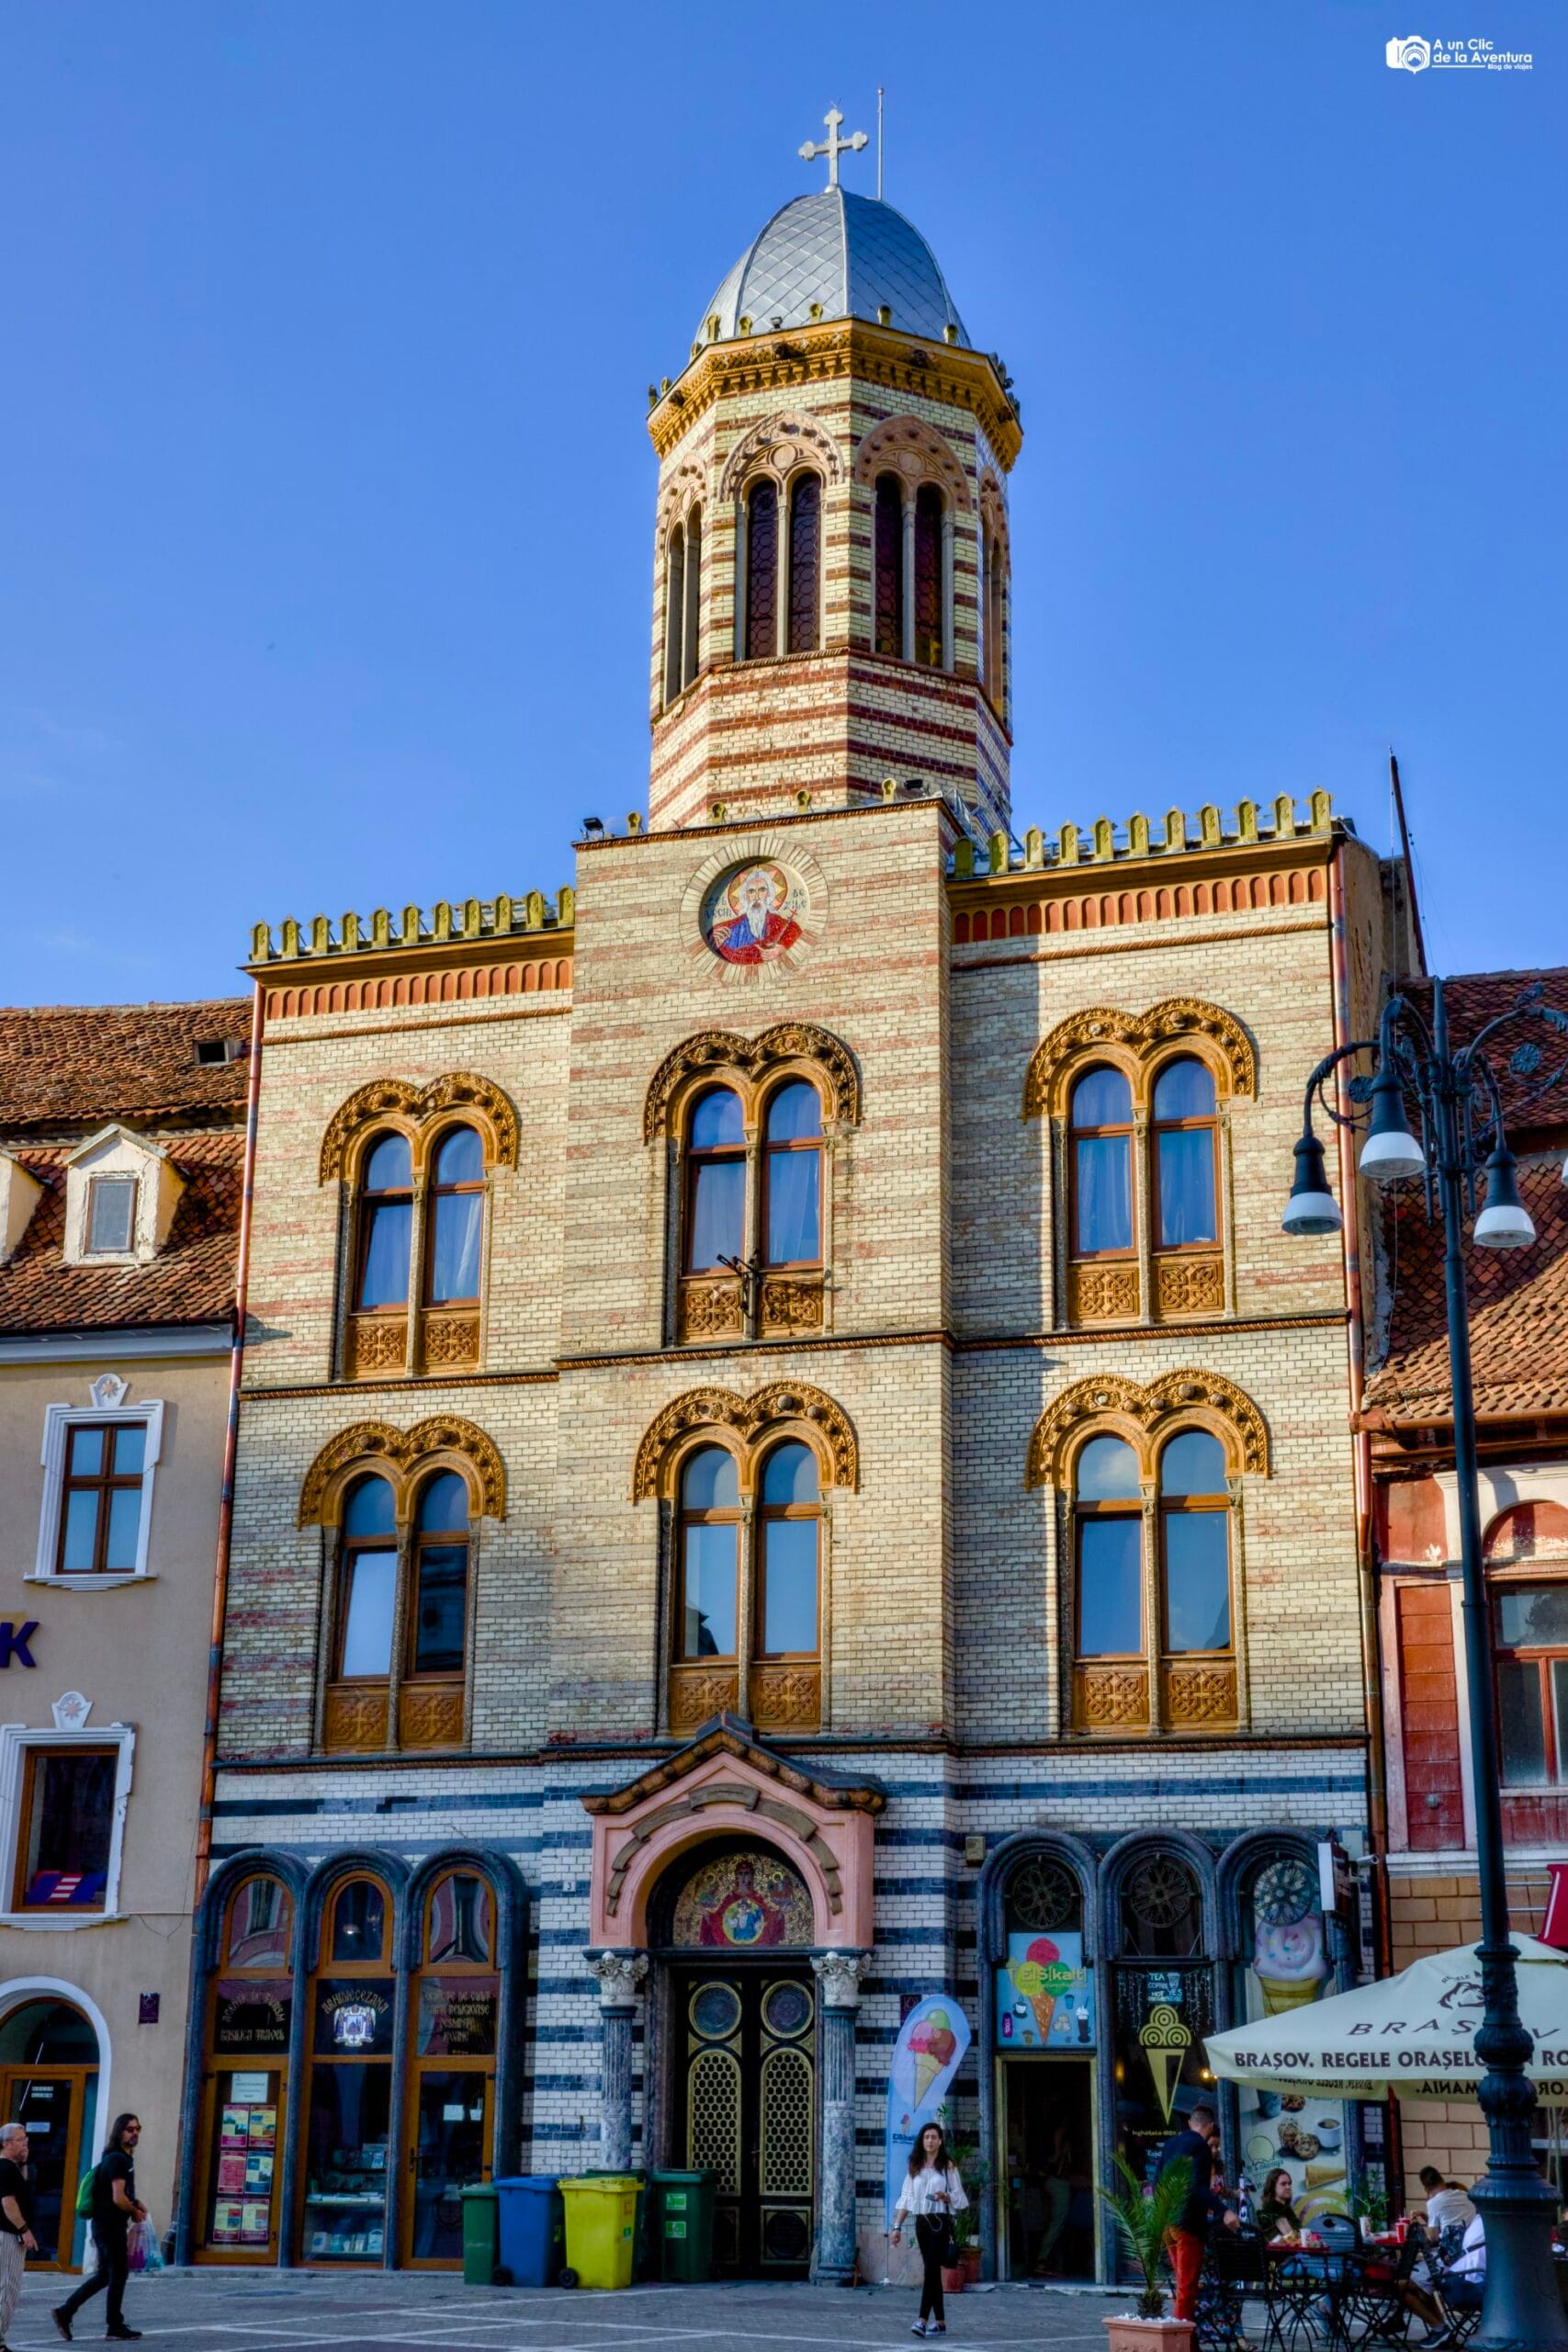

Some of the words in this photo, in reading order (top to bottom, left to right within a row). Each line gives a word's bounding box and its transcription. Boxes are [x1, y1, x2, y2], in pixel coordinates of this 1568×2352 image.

[0, 1622, 39, 1668] K
[567, 1882, 572, 1891] 3
[1148, 1972, 1166, 1982] TEA
[1348, 2018, 1562, 2038] BRAȘV
[1234, 2052, 1314, 2071] BRAȘOV.
[1321, 2052, 1391, 2068] REGELE
